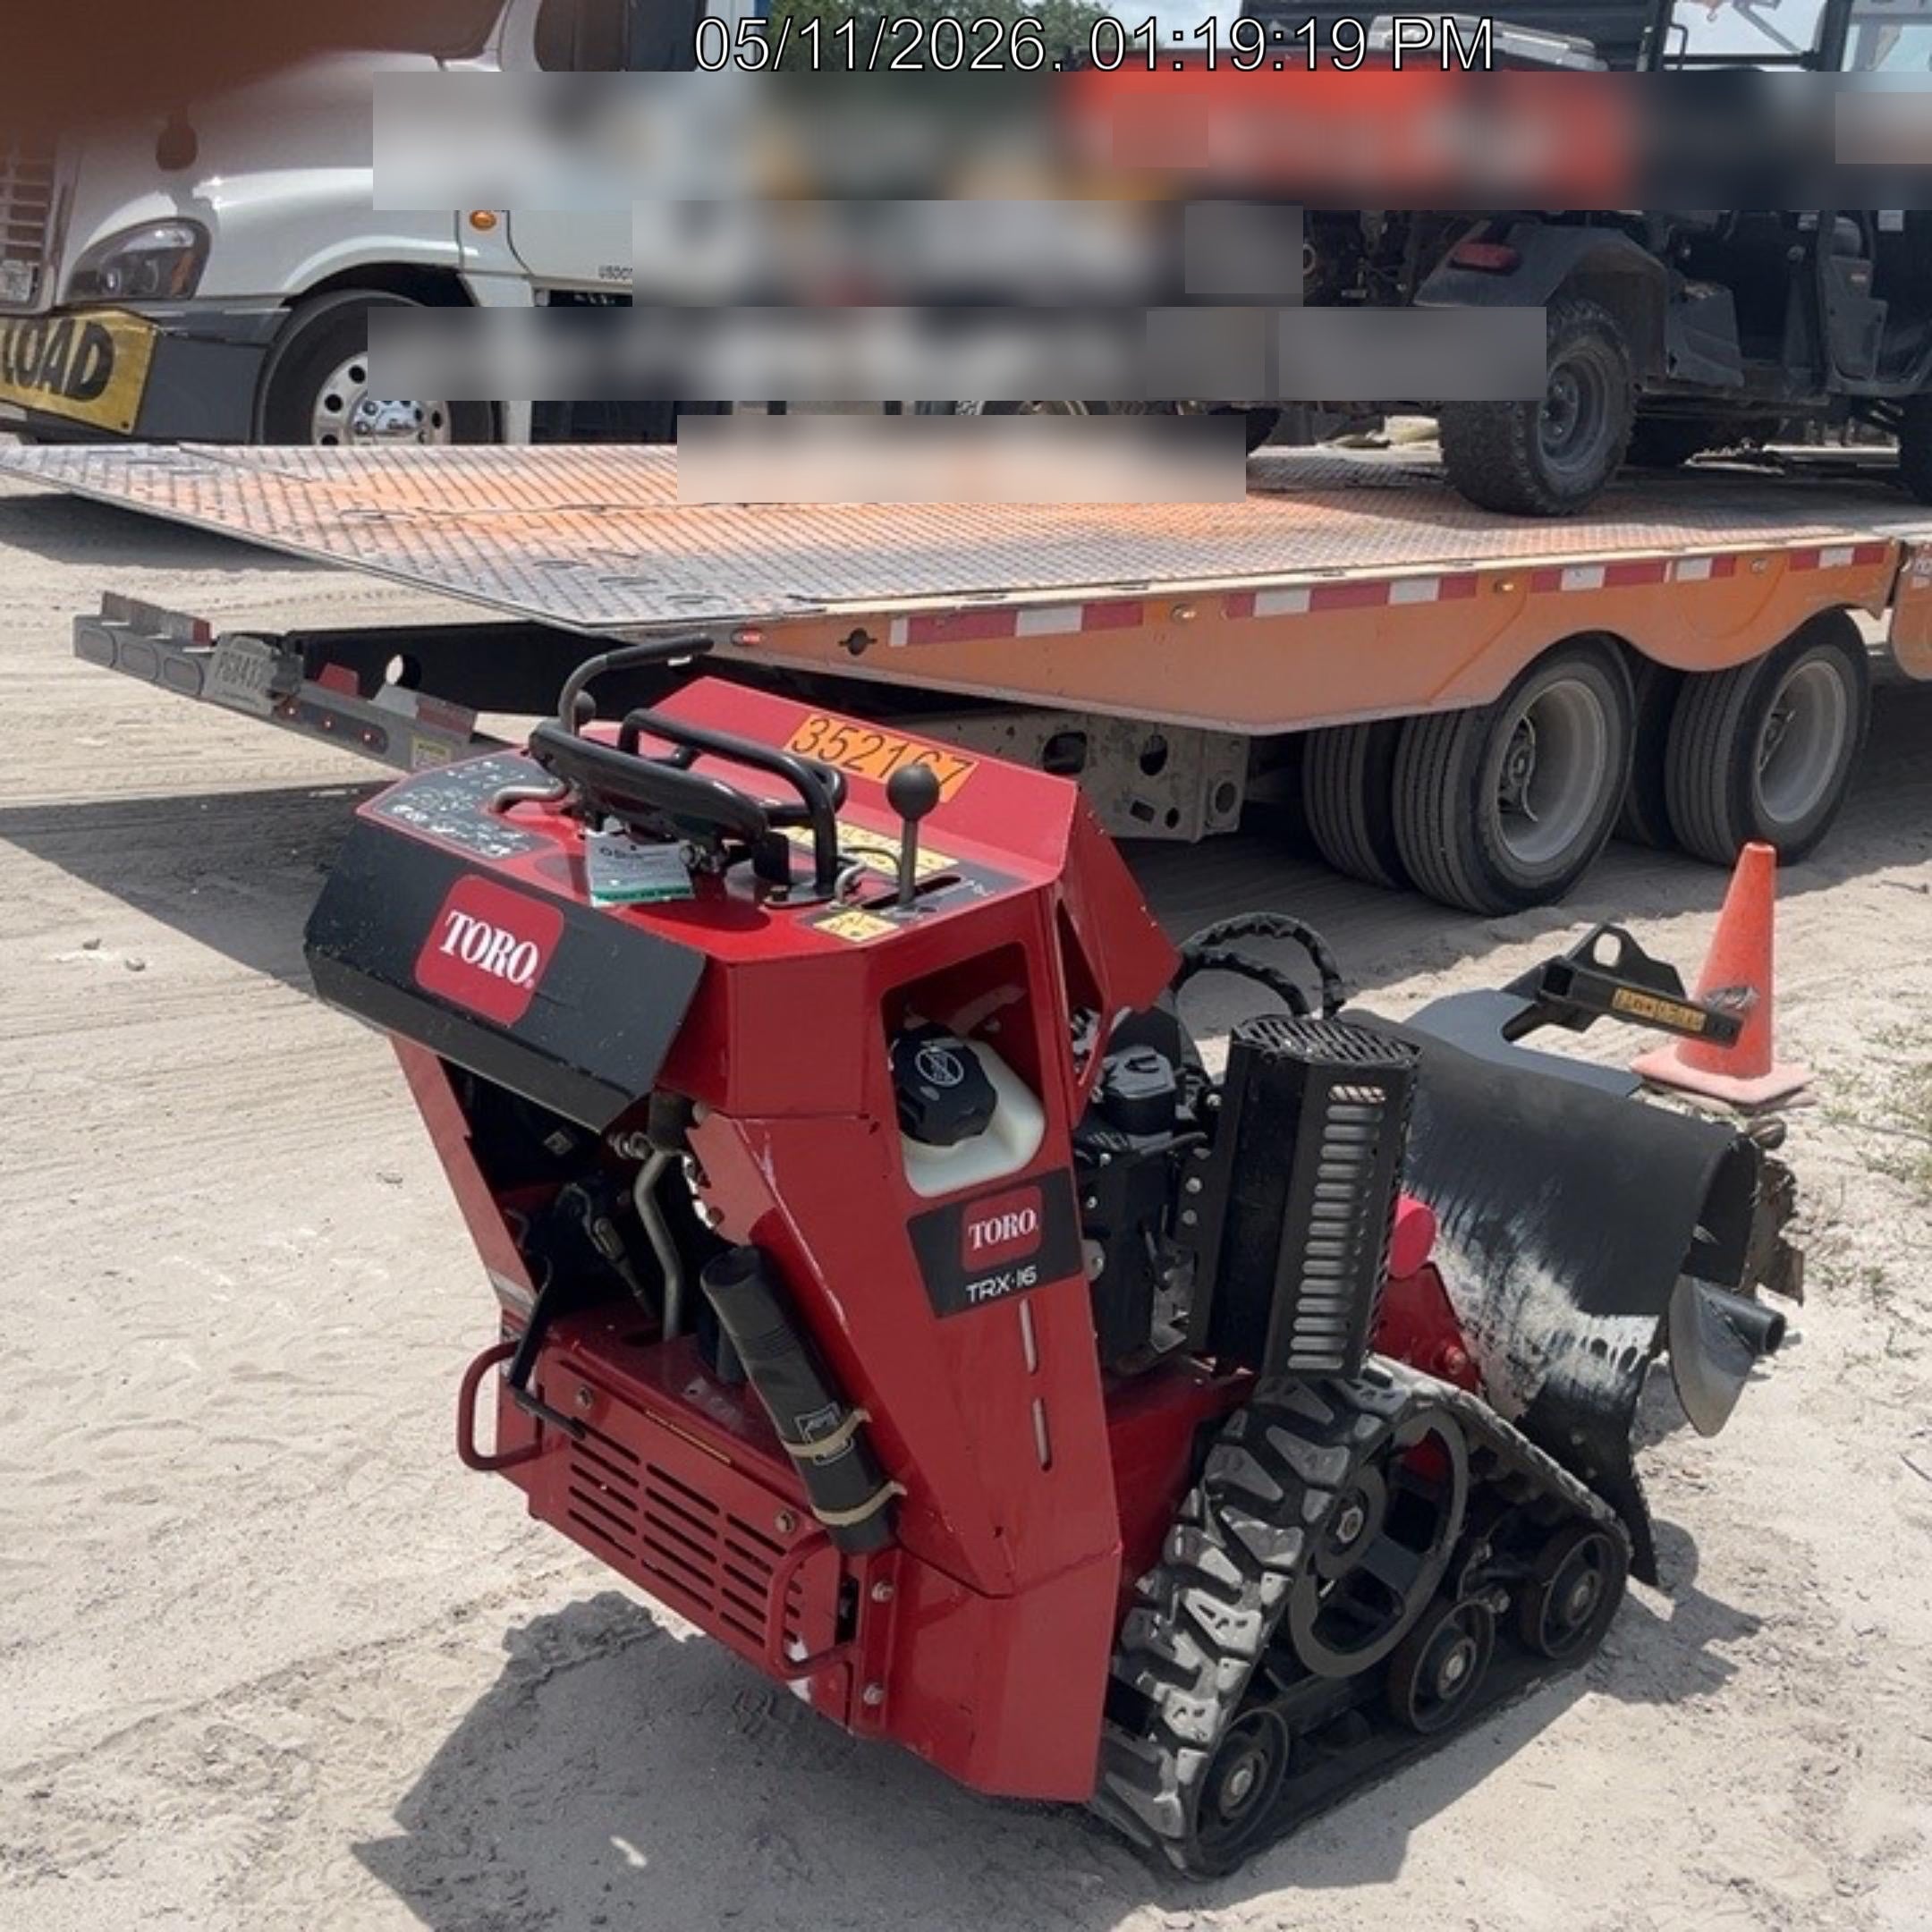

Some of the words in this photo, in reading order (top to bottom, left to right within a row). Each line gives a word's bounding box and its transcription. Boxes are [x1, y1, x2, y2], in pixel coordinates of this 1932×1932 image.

[3, 317, 114, 400] LOAD
[439, 909, 539, 987] TORO
[968, 1208, 1038, 1250] TORO
